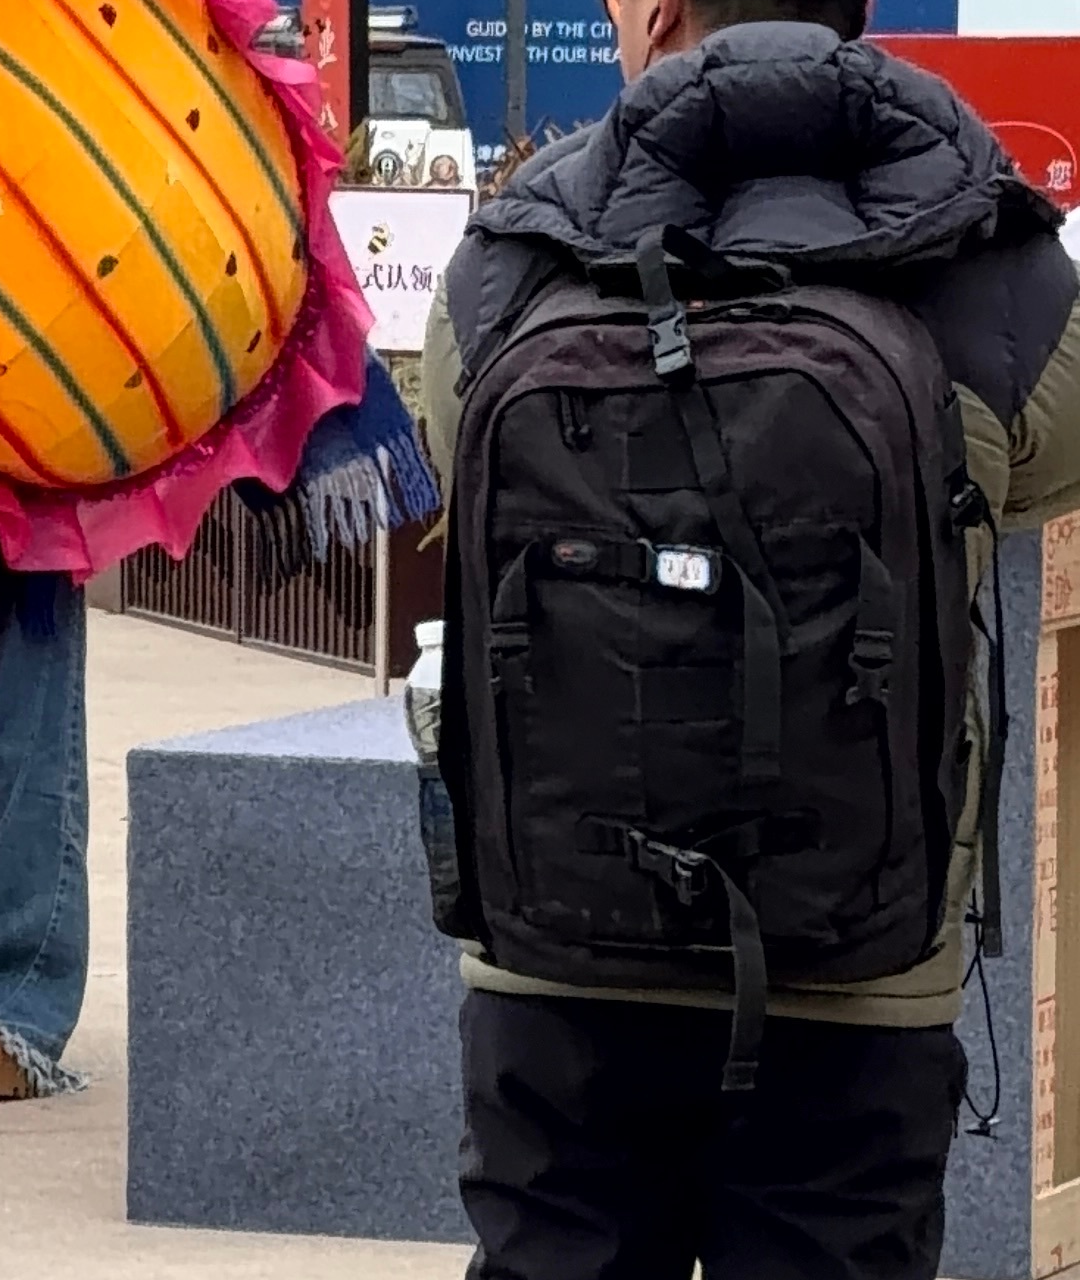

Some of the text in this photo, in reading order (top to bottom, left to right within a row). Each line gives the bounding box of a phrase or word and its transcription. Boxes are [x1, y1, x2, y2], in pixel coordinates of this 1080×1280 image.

[466, 20, 528, 38] GUID
[532, 21, 552, 38] BY
[551, 45, 588, 63] OUR
